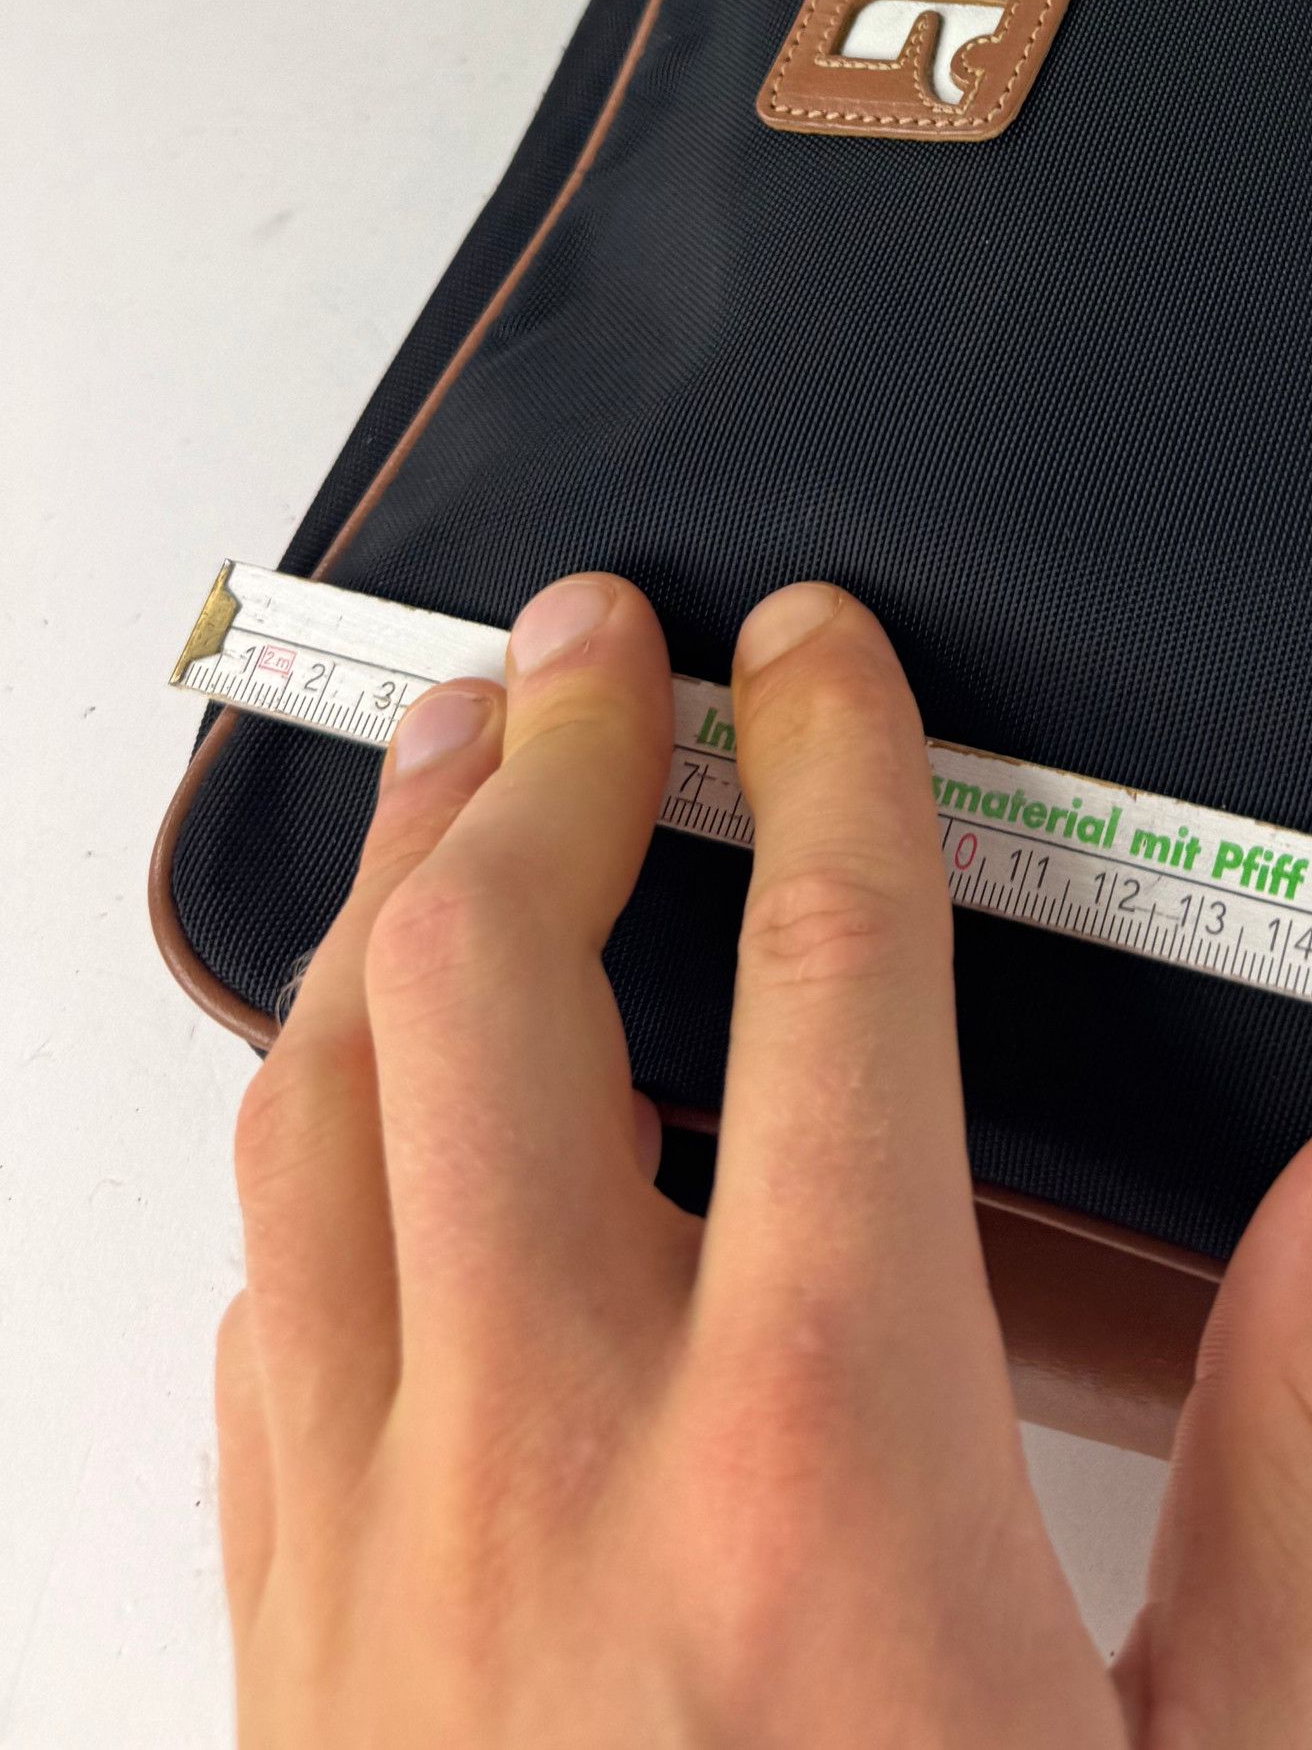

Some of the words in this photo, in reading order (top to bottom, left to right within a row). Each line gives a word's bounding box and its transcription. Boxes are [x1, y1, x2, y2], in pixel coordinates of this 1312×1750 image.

[303, 663, 326, 692] 2
[375, 681, 397, 711] 3
[679, 761, 700, 792] 7
[1010, 849, 1050, 888] 11
[1094, 872, 1141, 913] 12
[1180, 894, 1228, 936] 13
[1130, 826, 1201, 871] mit
[1211, 839, 1310, 901] Pfiff
